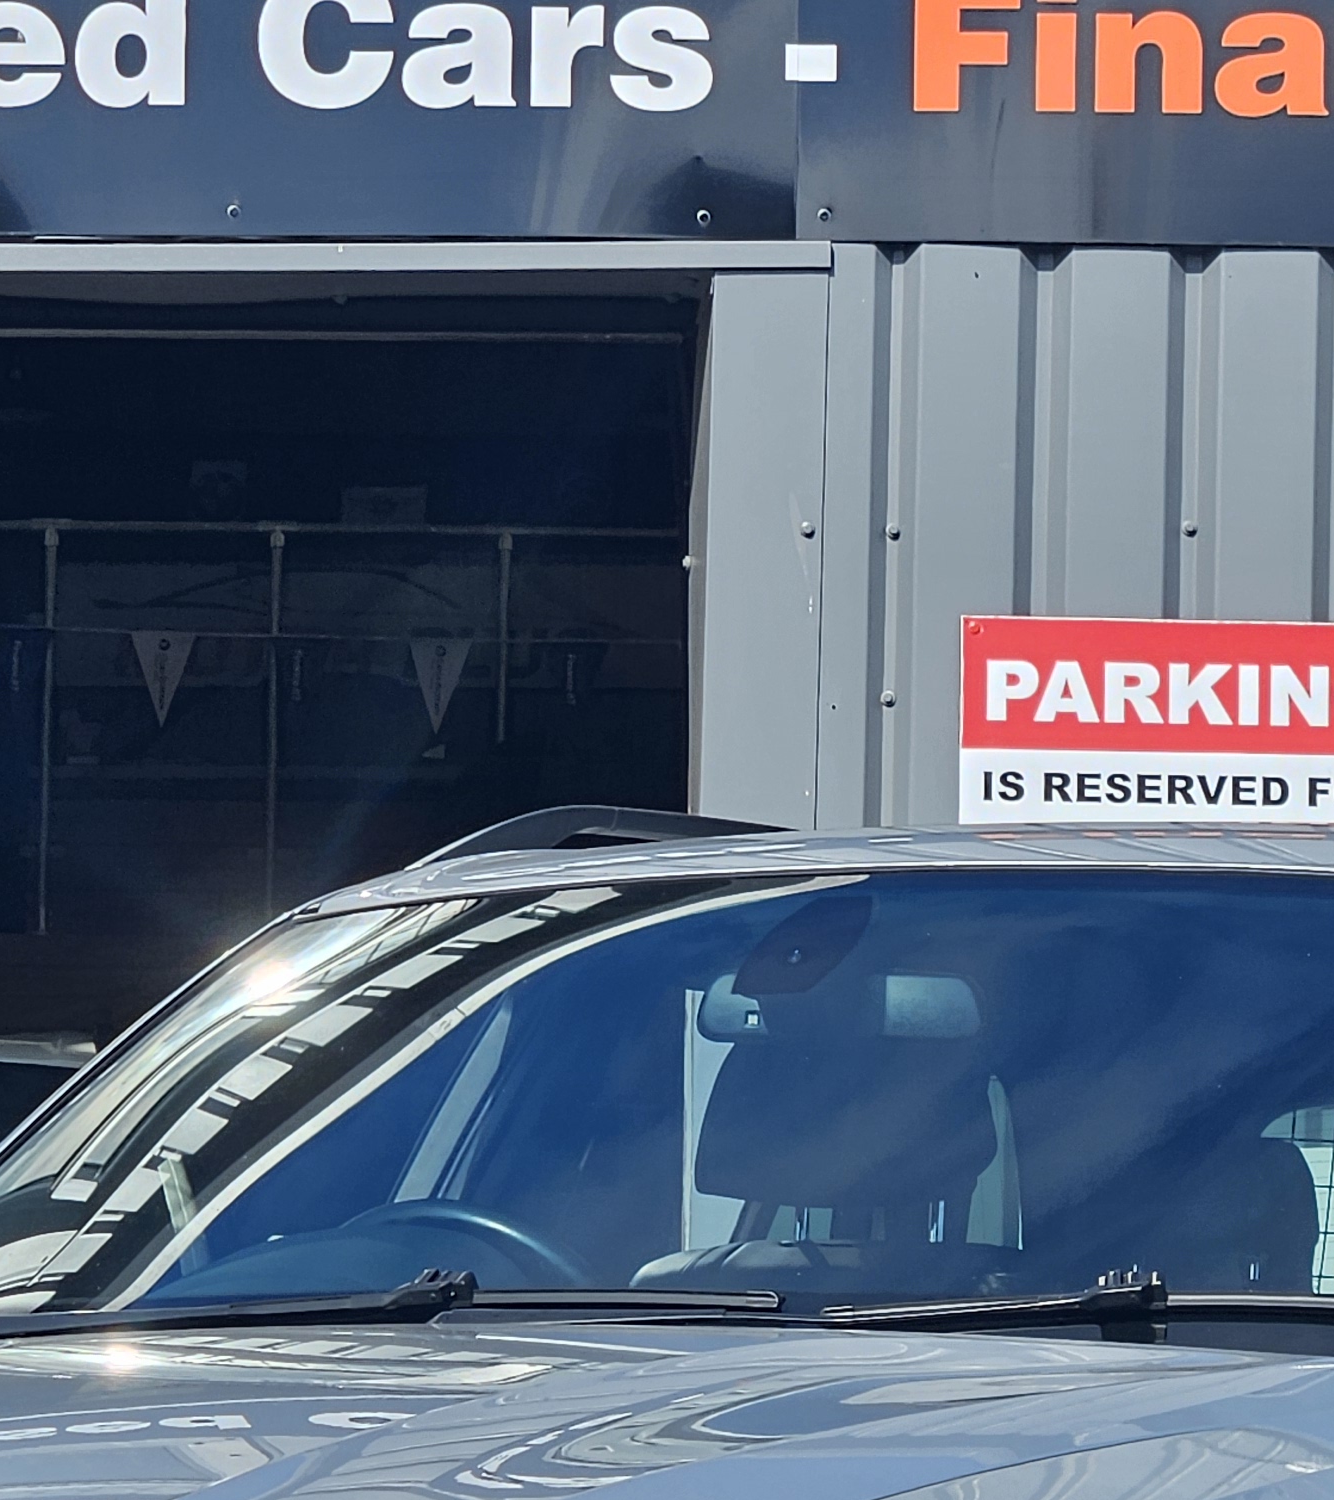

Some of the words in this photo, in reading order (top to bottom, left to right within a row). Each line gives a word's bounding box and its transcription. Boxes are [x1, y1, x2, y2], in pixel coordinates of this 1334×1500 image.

[258, 0, 714, 112] Cars
[983, 771, 1025, 801] IS
[1043, 772, 1289, 806] RESERVED
